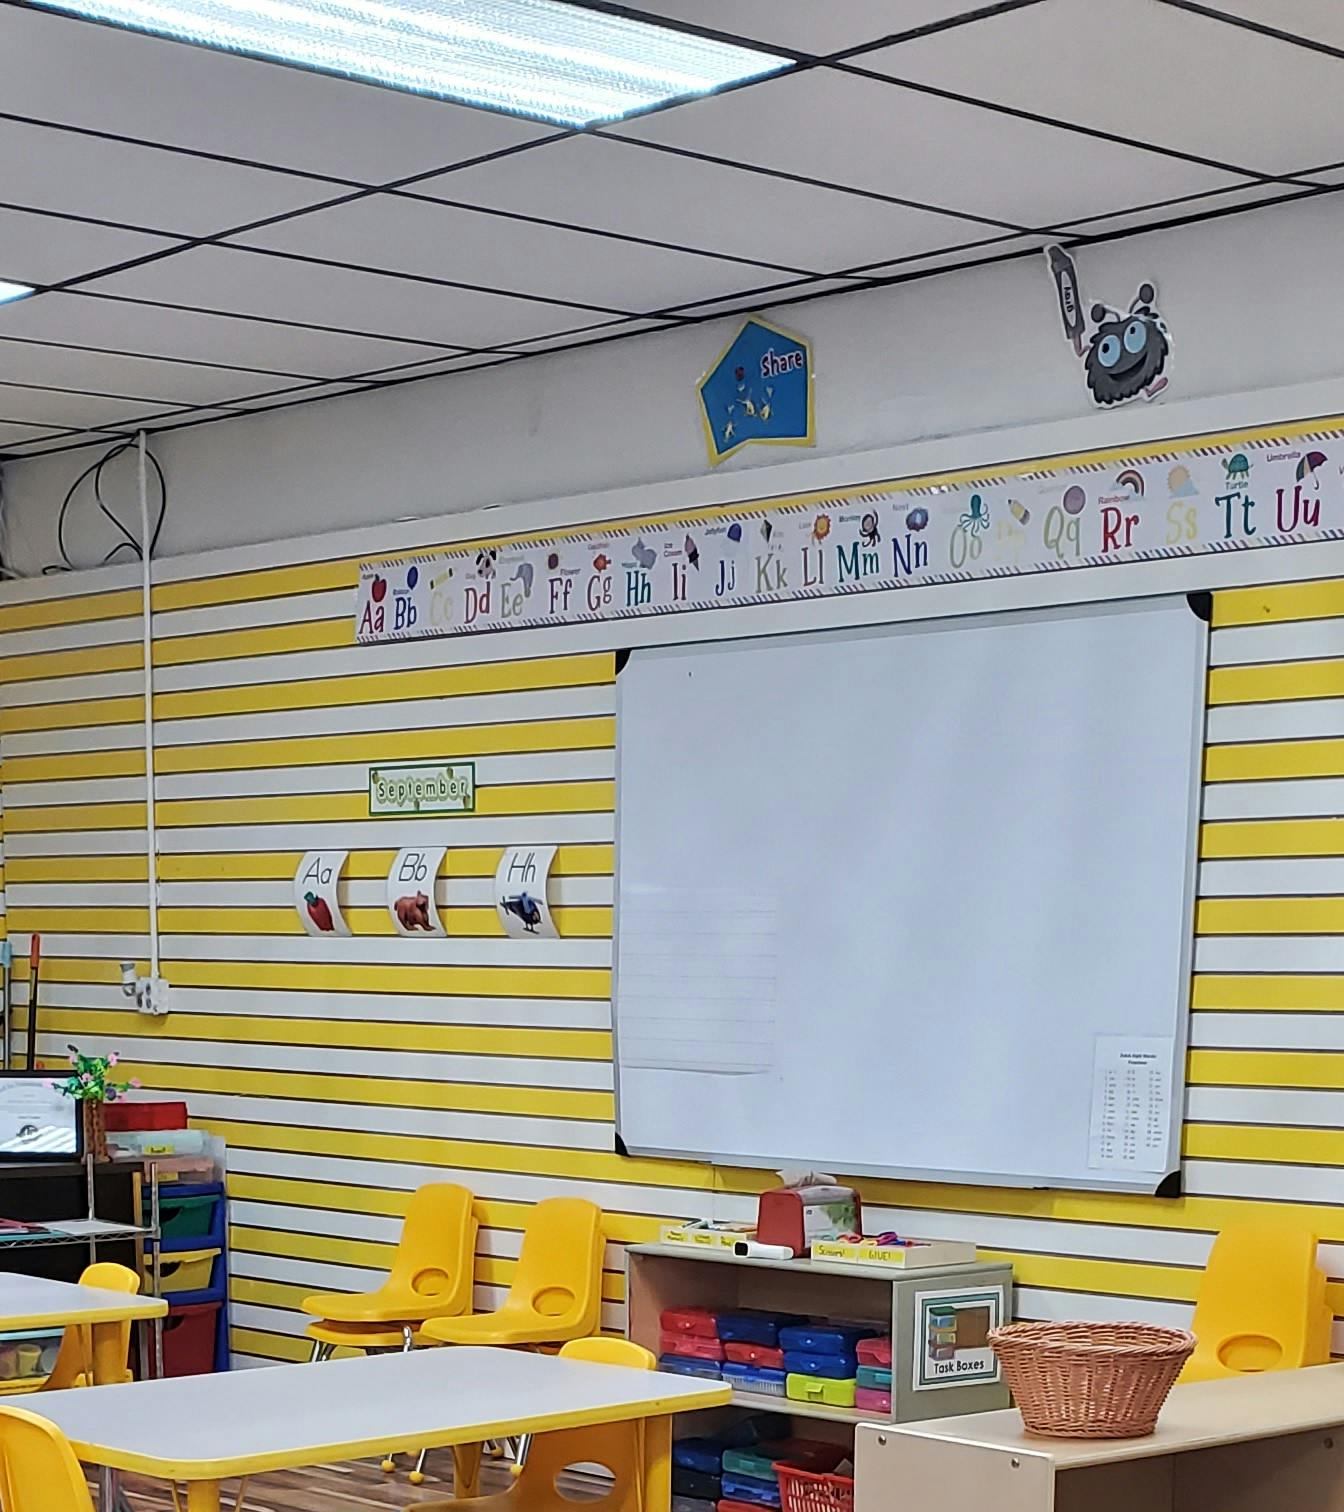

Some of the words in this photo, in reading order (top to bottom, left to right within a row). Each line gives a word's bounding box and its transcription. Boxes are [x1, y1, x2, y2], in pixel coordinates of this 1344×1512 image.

[1266, 451, 1302, 463] Umbrella
[1225, 481, 1250, 491] Turtle
[1098, 495, 1131, 505] Rainbow
[358, 600, 385, 634] Aa
[394, 597, 417, 630] Bb
[464, 581, 491, 624] Dd
[501, 583, 524, 618] Ee
[549, 577, 573, 614] Ff
[587, 575, 613, 612] Gg
[626, 570, 651, 607] Hh
[672, 562, 687, 601] Ii
[715, 560, 736, 597] Jj
[755, 553, 788, 593] Kk
[801, 547, 825, 587] Ll
[836, 541, 880, 583] Mm
[892, 534, 929, 577] Nn
[950, 526, 983, 569] Oo
[1043, 506, 1081, 559] Qq
[1100, 506, 1140, 554] Rr
[1166, 501, 1198, 545] Ss
[1215, 492, 1257, 539] Tt
[1275, 485, 1321, 534] Uu
[560, 568, 581, 576] Flower
[377, 779, 468, 803] September
[302, 857, 333, 885] Aa
[398, 853, 428, 882] Bb
[507, 852, 537, 883] Hh
[934, 1362, 954, 1375] Task
[956, 1360, 985, 1373] Boxes
